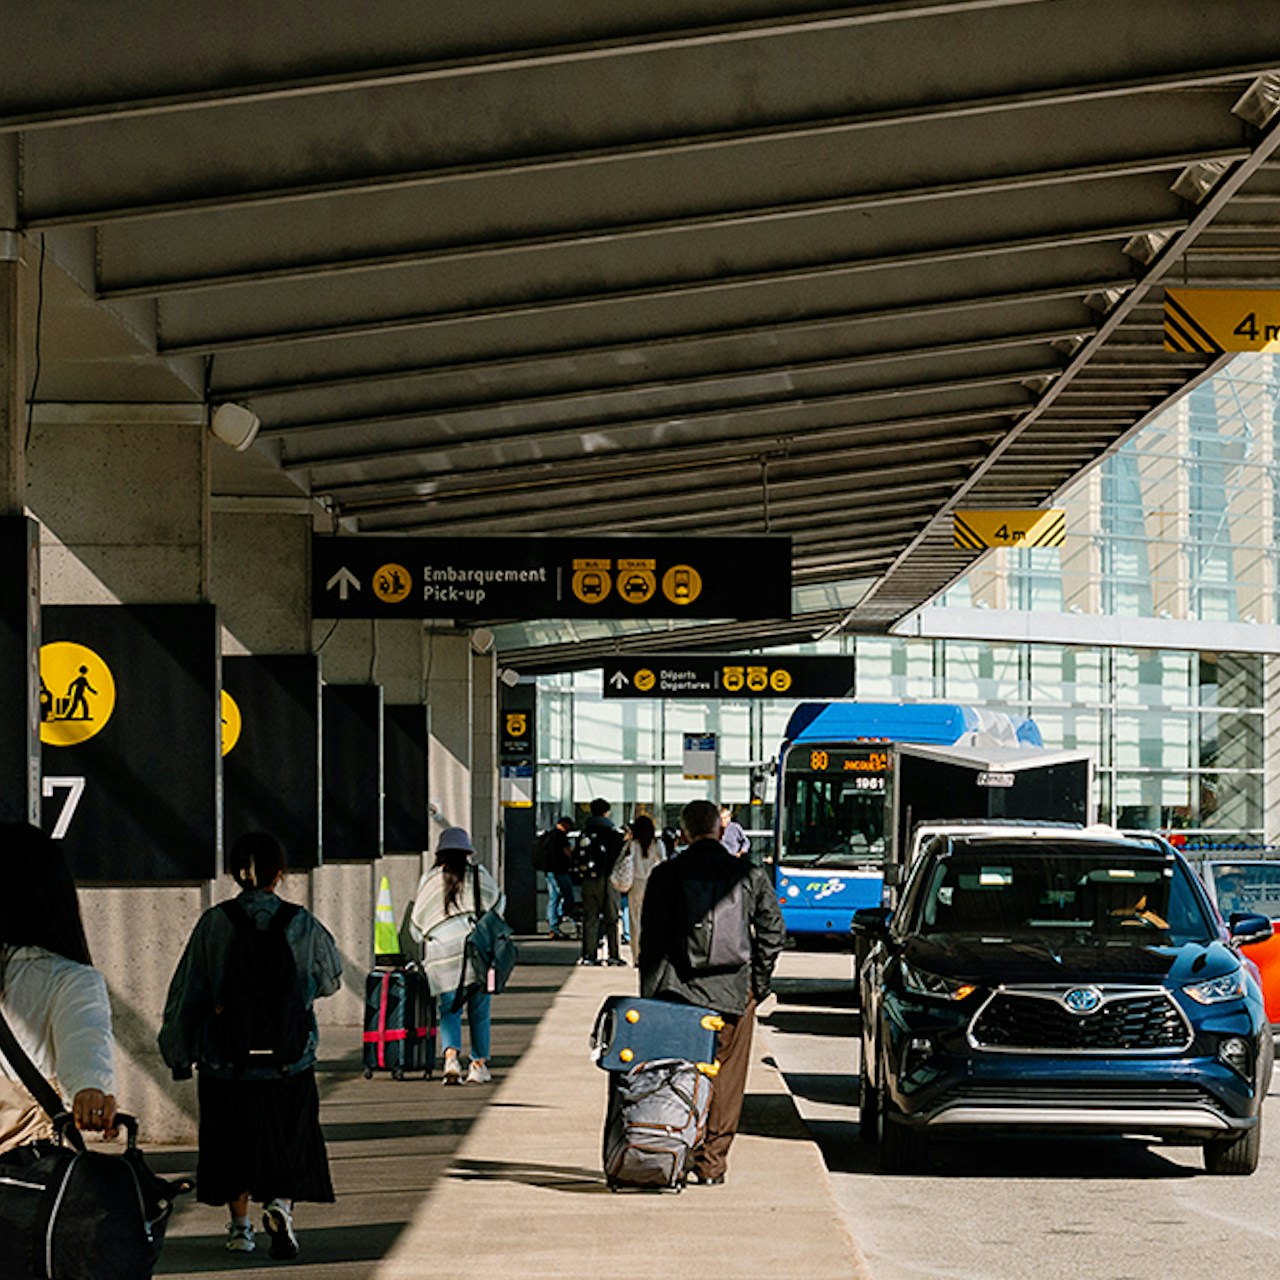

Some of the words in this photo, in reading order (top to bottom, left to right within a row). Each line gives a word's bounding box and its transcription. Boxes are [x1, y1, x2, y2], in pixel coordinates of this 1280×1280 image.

[423, 566, 547, 586] Embarquement
[423, 585, 486, 604] Pick-up
[660, 680, 711, 691] Departures
[810, 751, 829, 771] 80
[41, 776, 86, 839] 7
